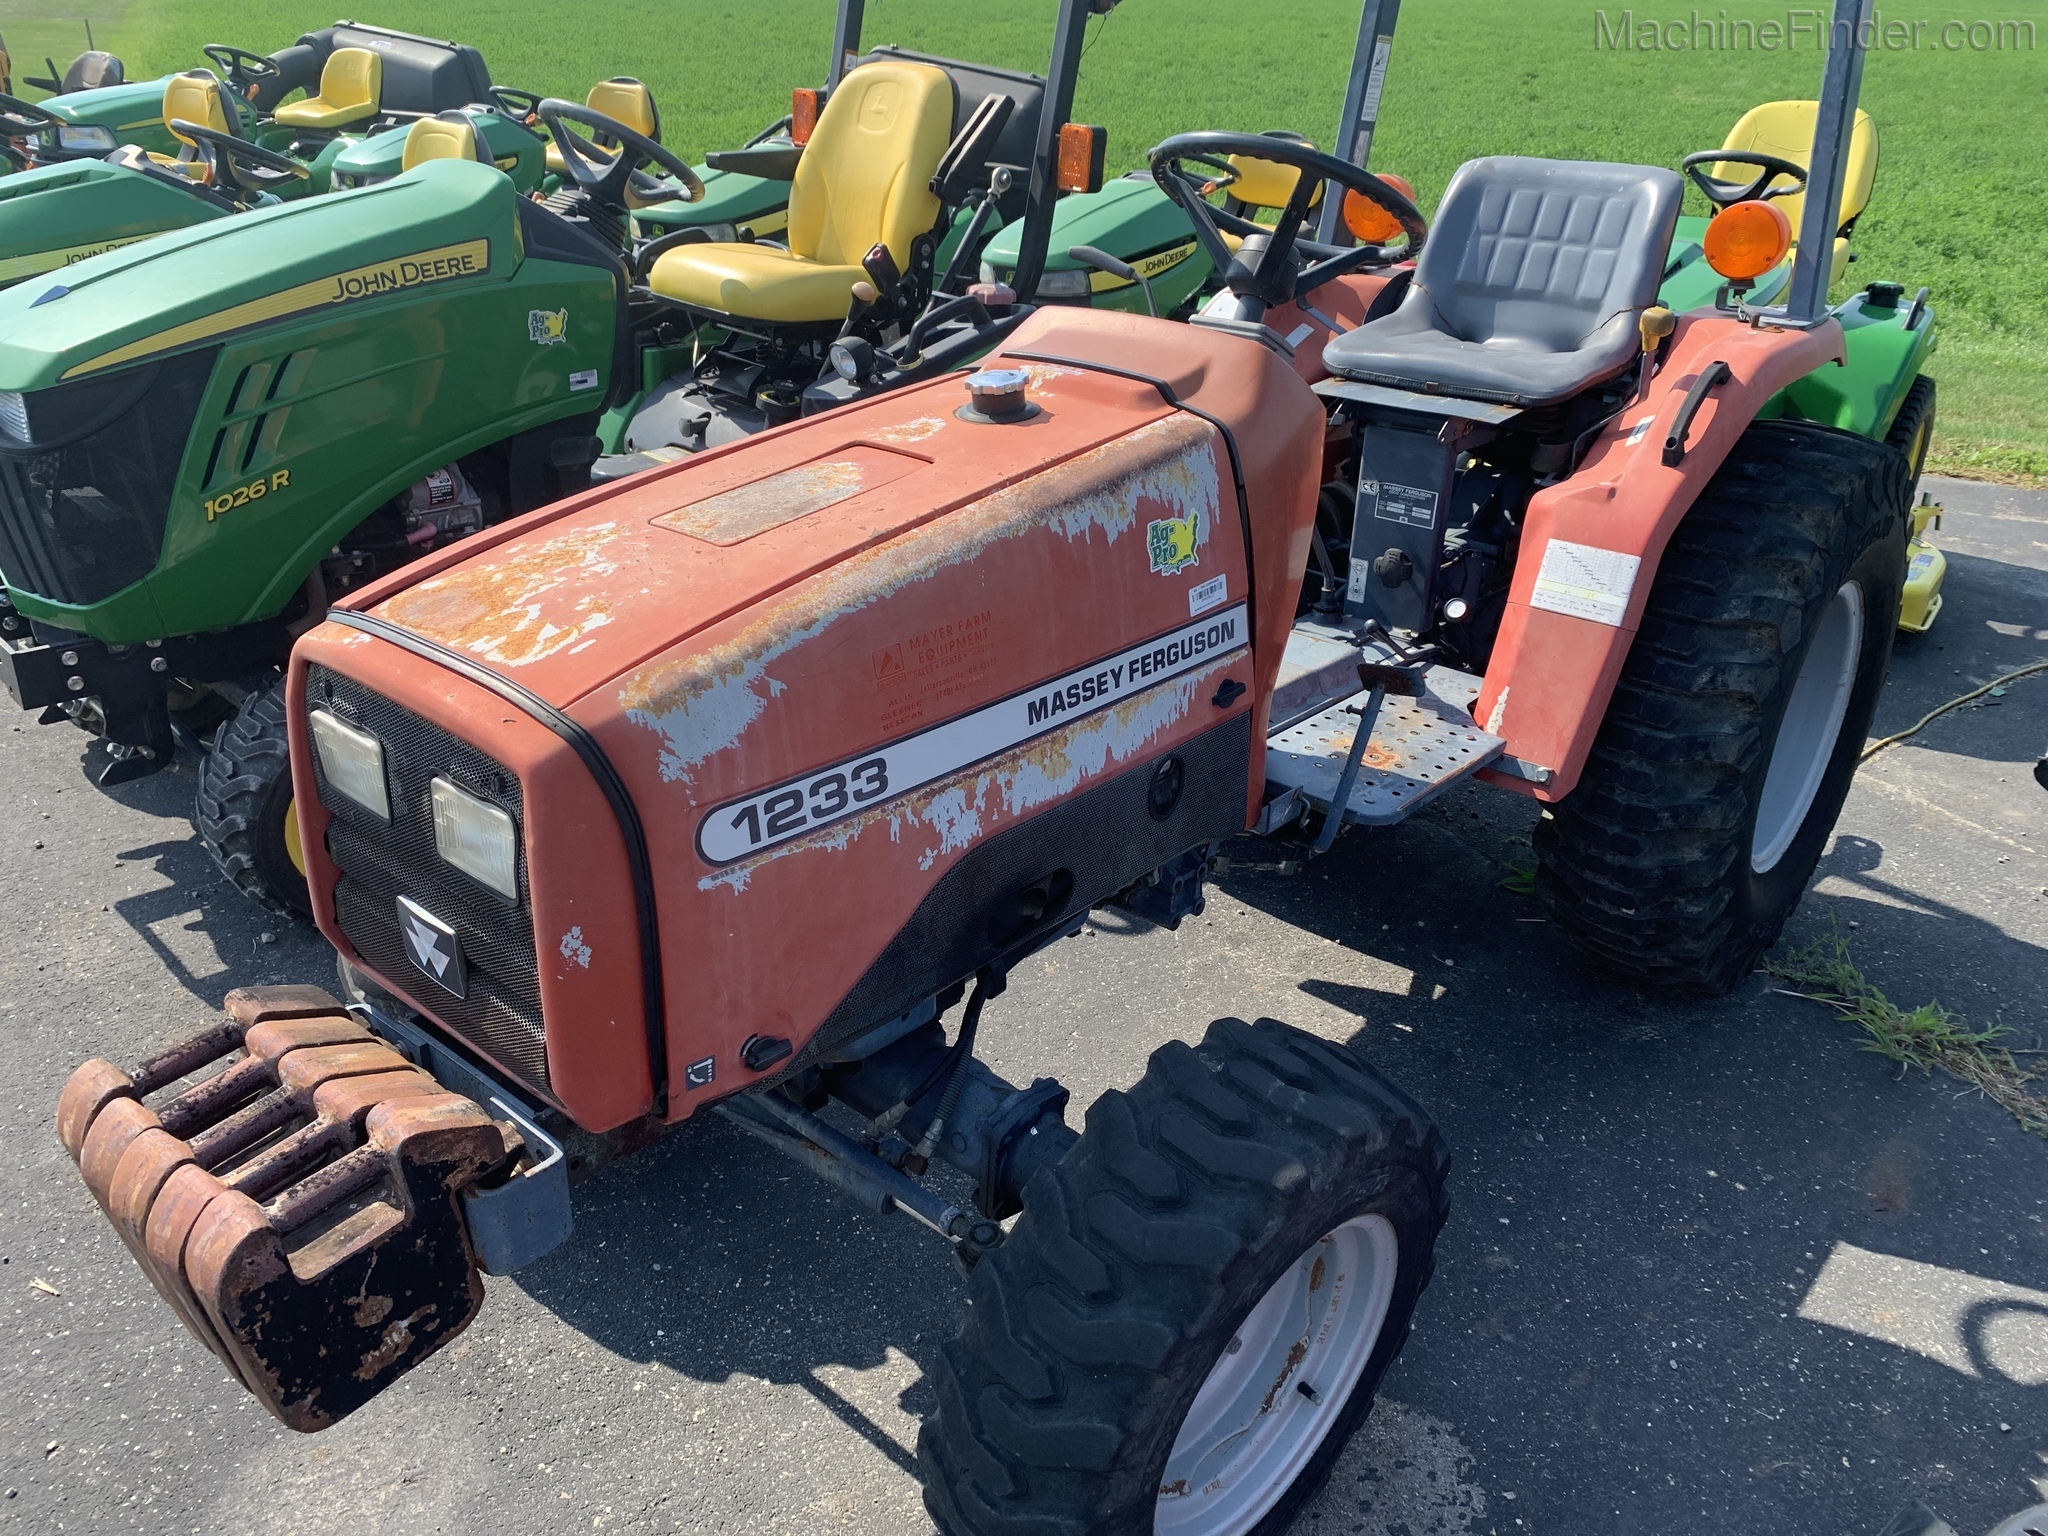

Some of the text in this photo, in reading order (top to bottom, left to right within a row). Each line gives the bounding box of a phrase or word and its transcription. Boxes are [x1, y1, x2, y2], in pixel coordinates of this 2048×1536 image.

[1143, 248, 1188, 274] JOHN DEERE
[332, 255, 476, 300] JOHN DEERE
[531, 325, 550, 338] Pro
[204, 469, 291, 522] 1026 R
[1151, 542, 1178, 568] Pro
[909, 610, 992, 650] MAYER FARM
[918, 627, 989, 664] EQUIPMENT
[913, 665, 934, 679] SALES
[941, 654, 962, 668] PARTS
[1027, 618, 1235, 726] MASSEY FERGUSON
[881, 699, 922, 721] GLEANER
[888, 693, 913, 707] ALLIS
[731, 758, 889, 846] 1233
